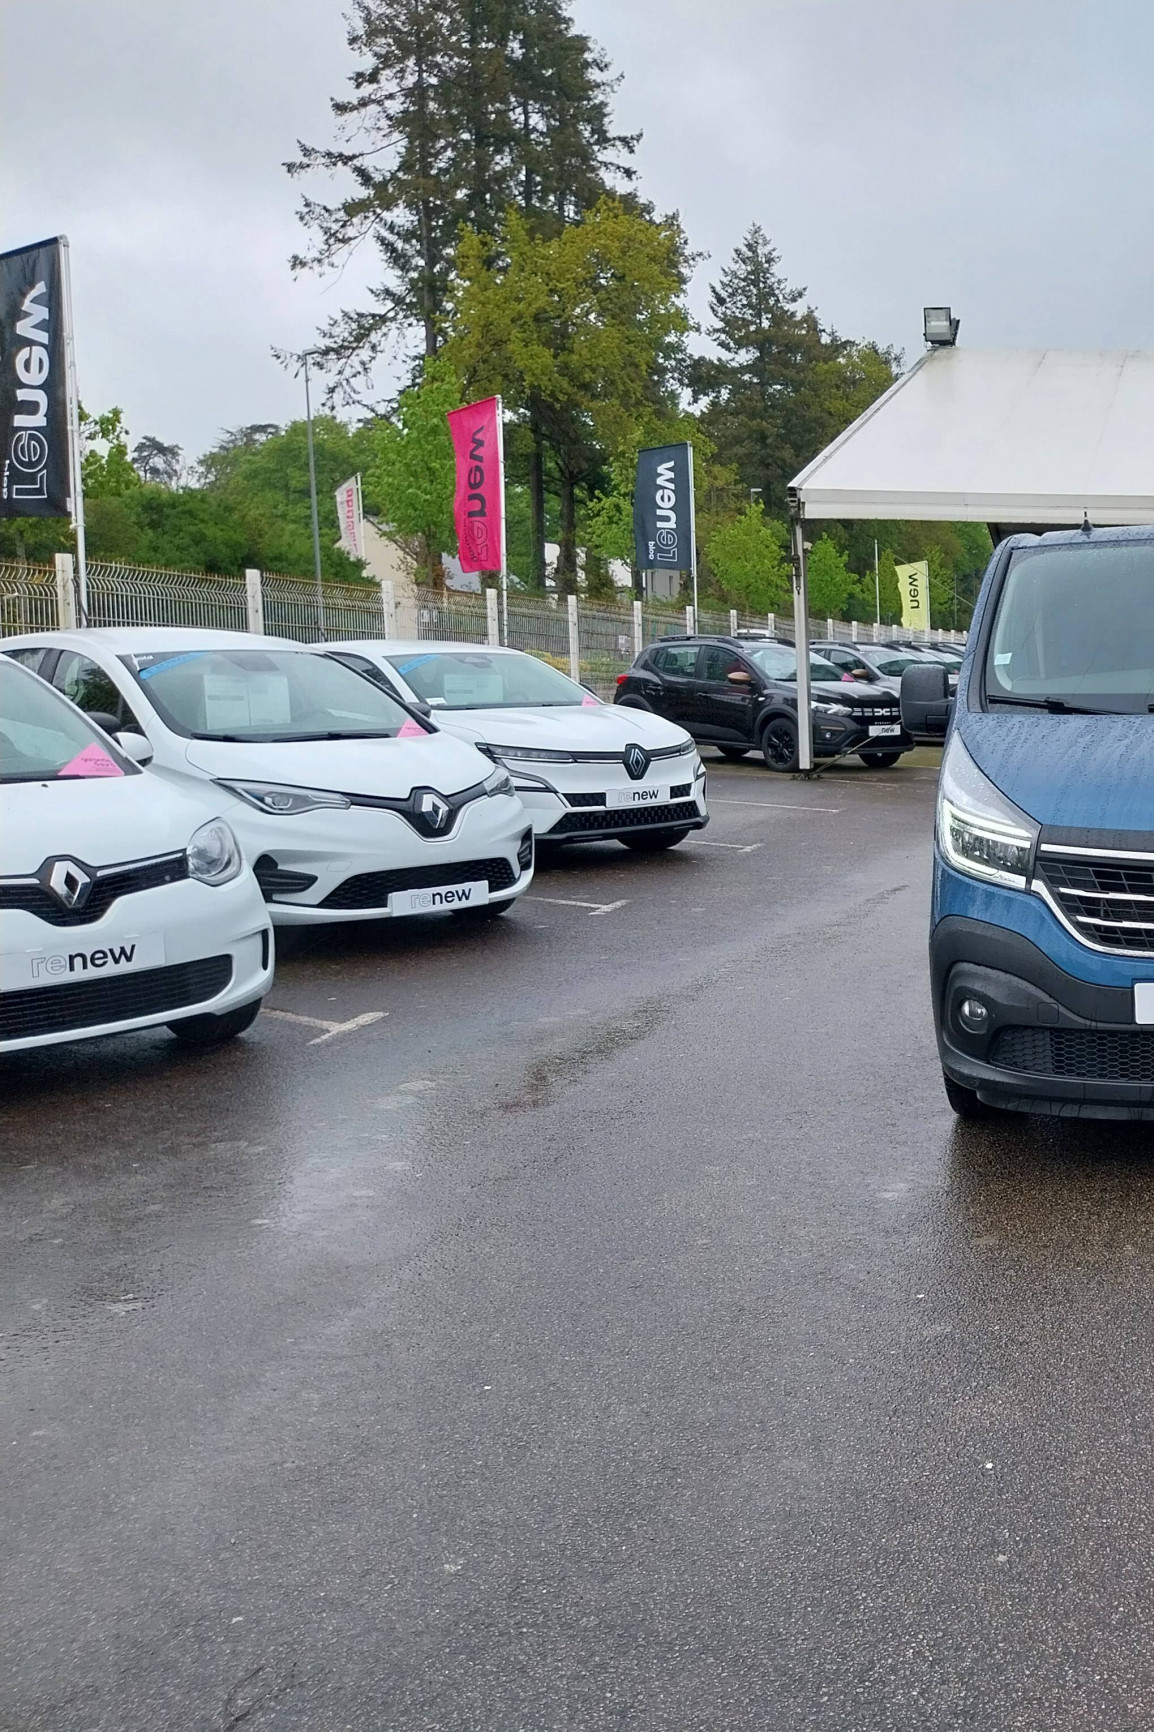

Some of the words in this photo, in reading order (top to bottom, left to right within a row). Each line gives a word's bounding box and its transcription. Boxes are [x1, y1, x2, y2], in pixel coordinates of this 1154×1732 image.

[618, 789, 659, 803] renew
[410, 888, 471, 909] renew
[31, 943, 136, 978] renew
